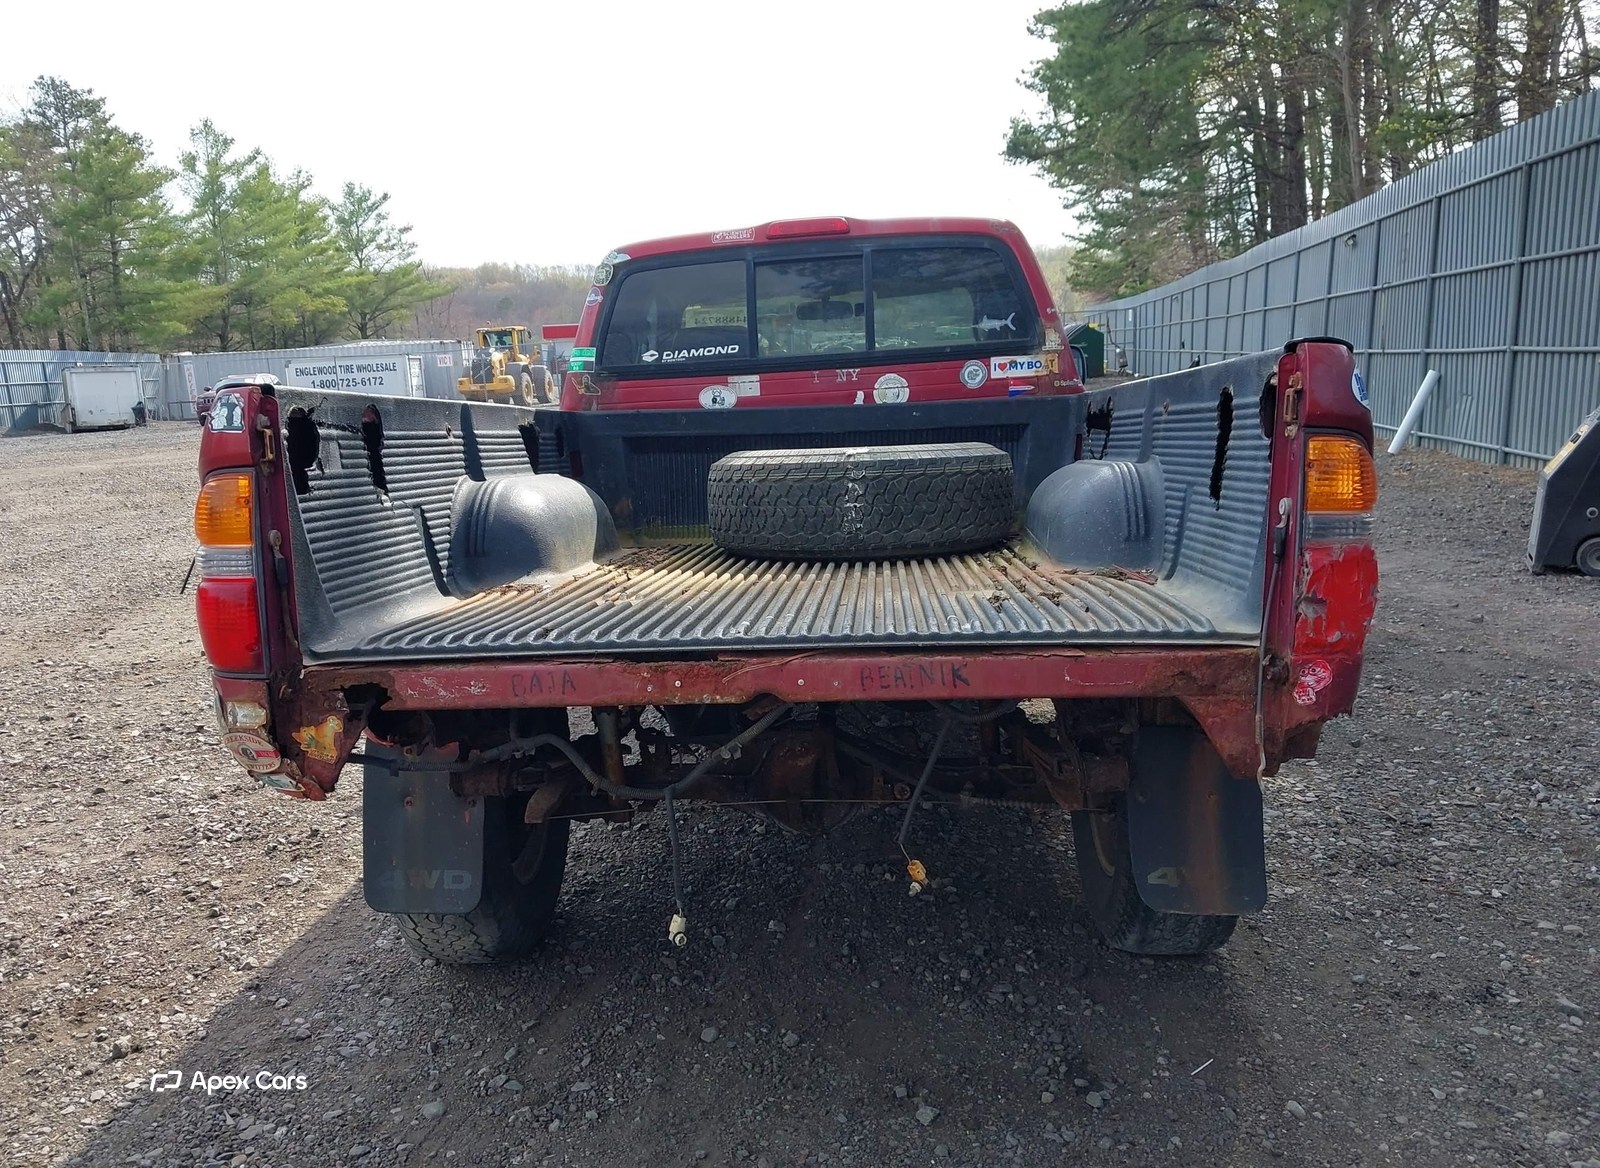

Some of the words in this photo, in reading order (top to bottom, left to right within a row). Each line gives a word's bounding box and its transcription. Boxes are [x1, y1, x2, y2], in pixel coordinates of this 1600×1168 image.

[662, 344, 740, 360] DIAMOND
[294, 365, 337, 377] ENGLEWOOD
[338, 364, 355, 375] TIRE
[355, 362, 397, 374] WHOLESALE
[1009, 361, 1026, 371] MY
[835, 368, 861, 383] NY
[860, 660, 971, 692] BEATNIK
